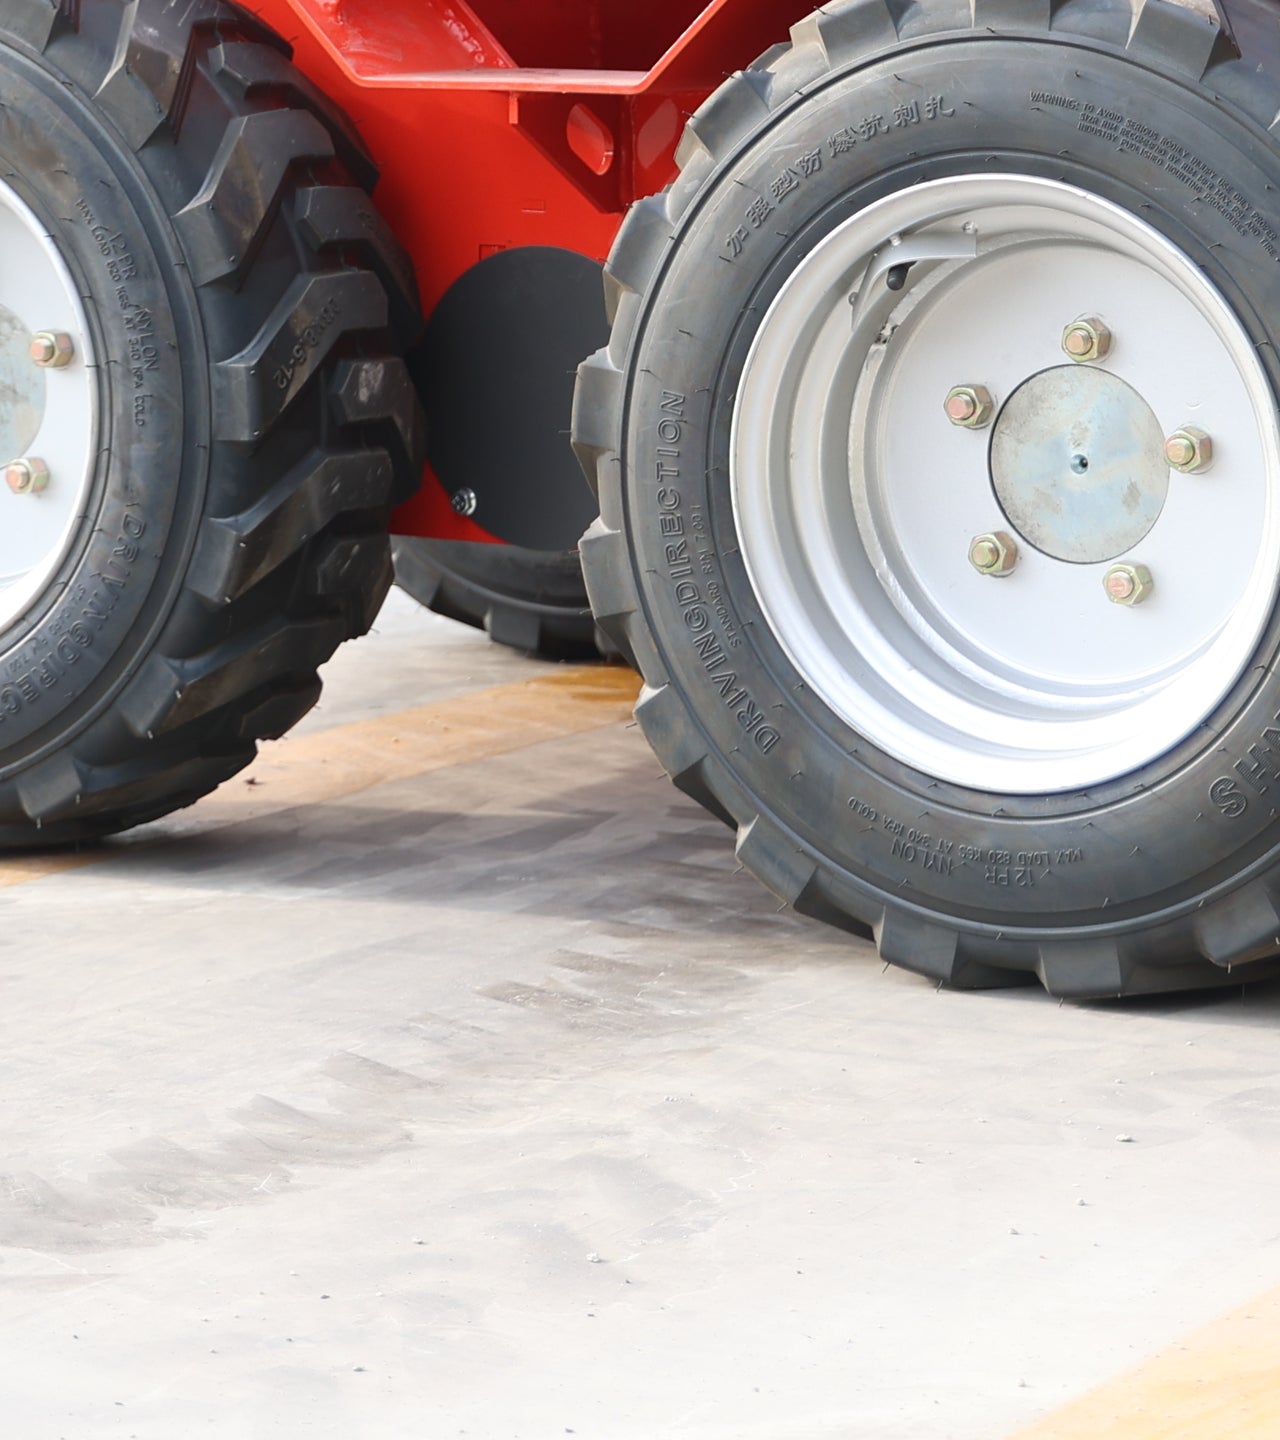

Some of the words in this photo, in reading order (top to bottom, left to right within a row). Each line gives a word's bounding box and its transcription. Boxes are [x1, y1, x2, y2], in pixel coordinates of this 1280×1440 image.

[1028, 90, 1081, 111] WARNING:
[133, 305, 159, 371] NYLON
[654, 385, 783, 756] DRIVINGDIRECTION
[843, 793, 880, 824] COLD
[878, 813, 906, 838] KPA
[887, 836, 954, 876] NYLON
[934, 837, 954, 856] AT
[1016, 847, 1052, 867] LOAD
[1054, 844, 1084, 865] MAX
